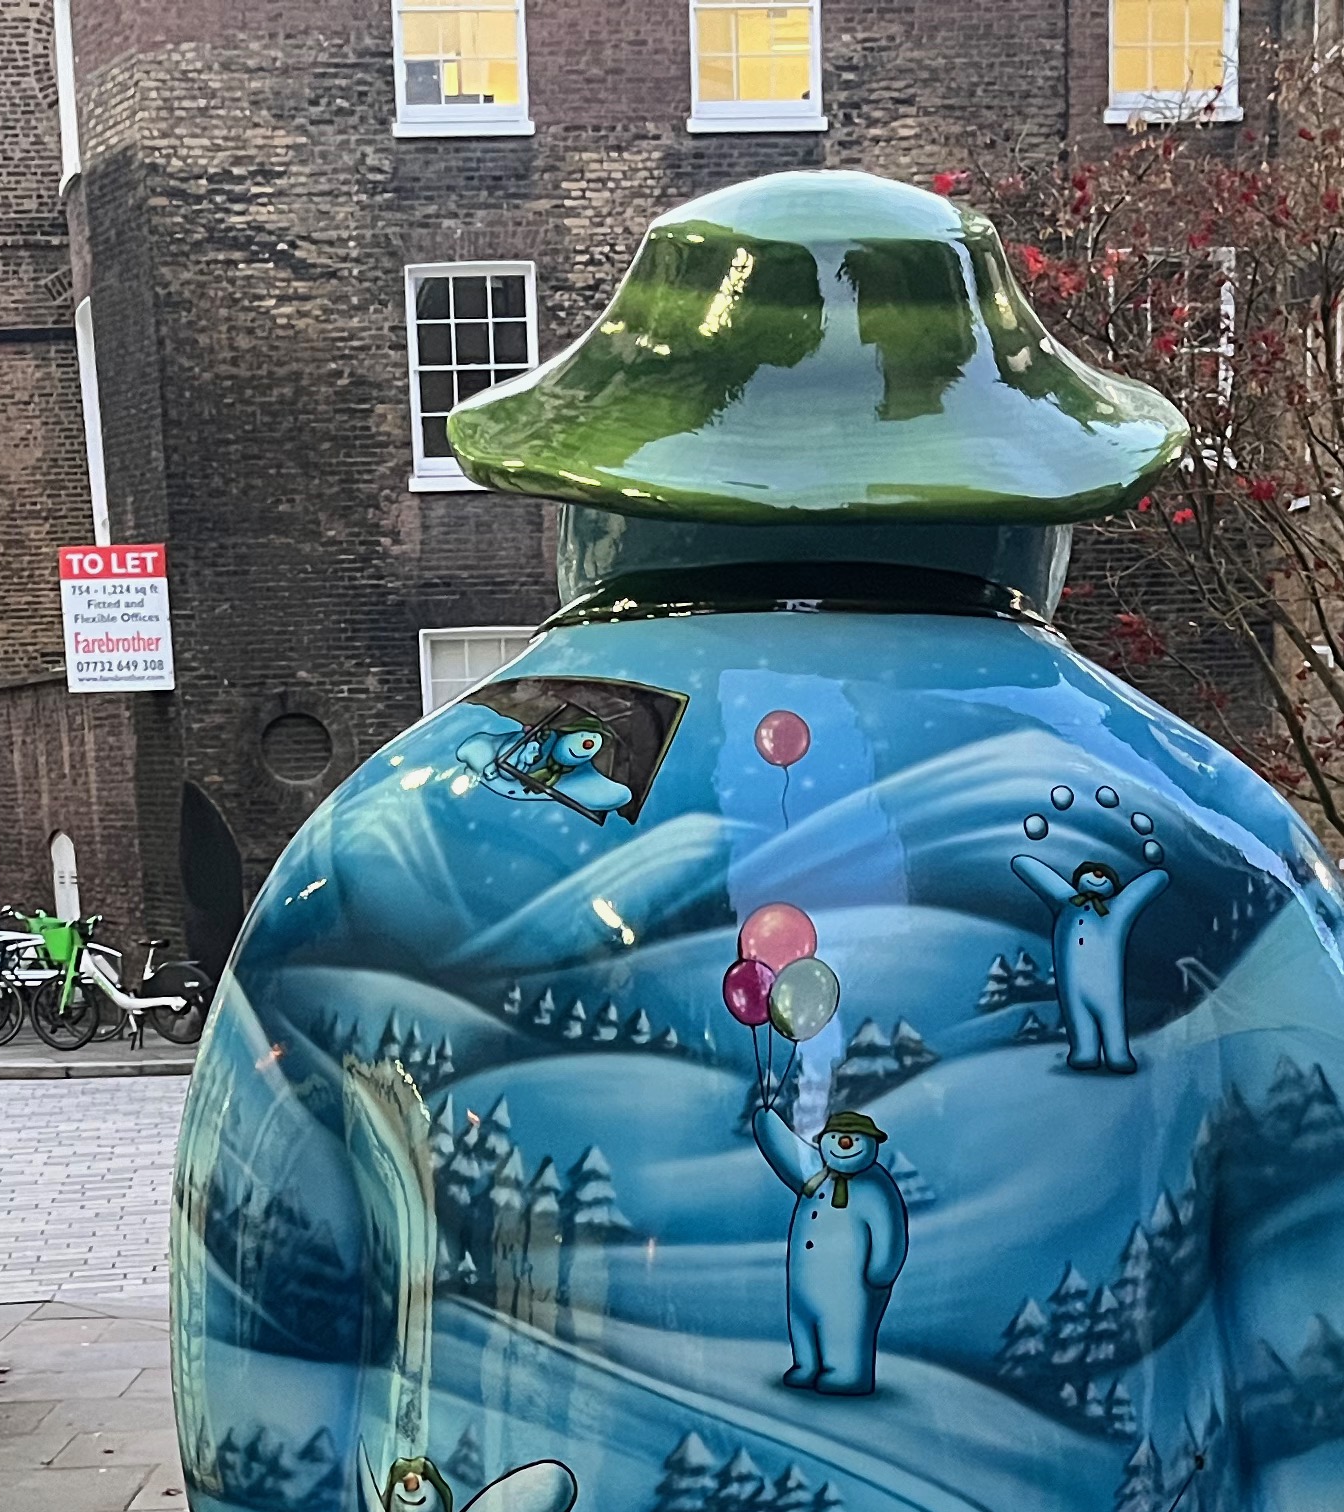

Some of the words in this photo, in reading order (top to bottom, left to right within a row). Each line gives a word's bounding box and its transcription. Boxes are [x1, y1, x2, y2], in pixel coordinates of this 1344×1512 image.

[66, 553, 104, 575] TO
[111, 551, 159, 574] LET
[71, 585, 90, 596] 754
[102, 584, 131, 597] 1,224
[135, 586, 146, 597] sq
[149, 583, 159, 594] ft
[87, 599, 120, 609] Fitted
[124, 598, 145, 608] and
[74, 613, 117, 624] Flexible
[120, 612, 160, 623] Offices
[74, 630, 161, 654] Farebrother
[76, 660, 113, 672] 07732
[117, 659, 139, 672] 649
[143, 659, 165, 671] 308
